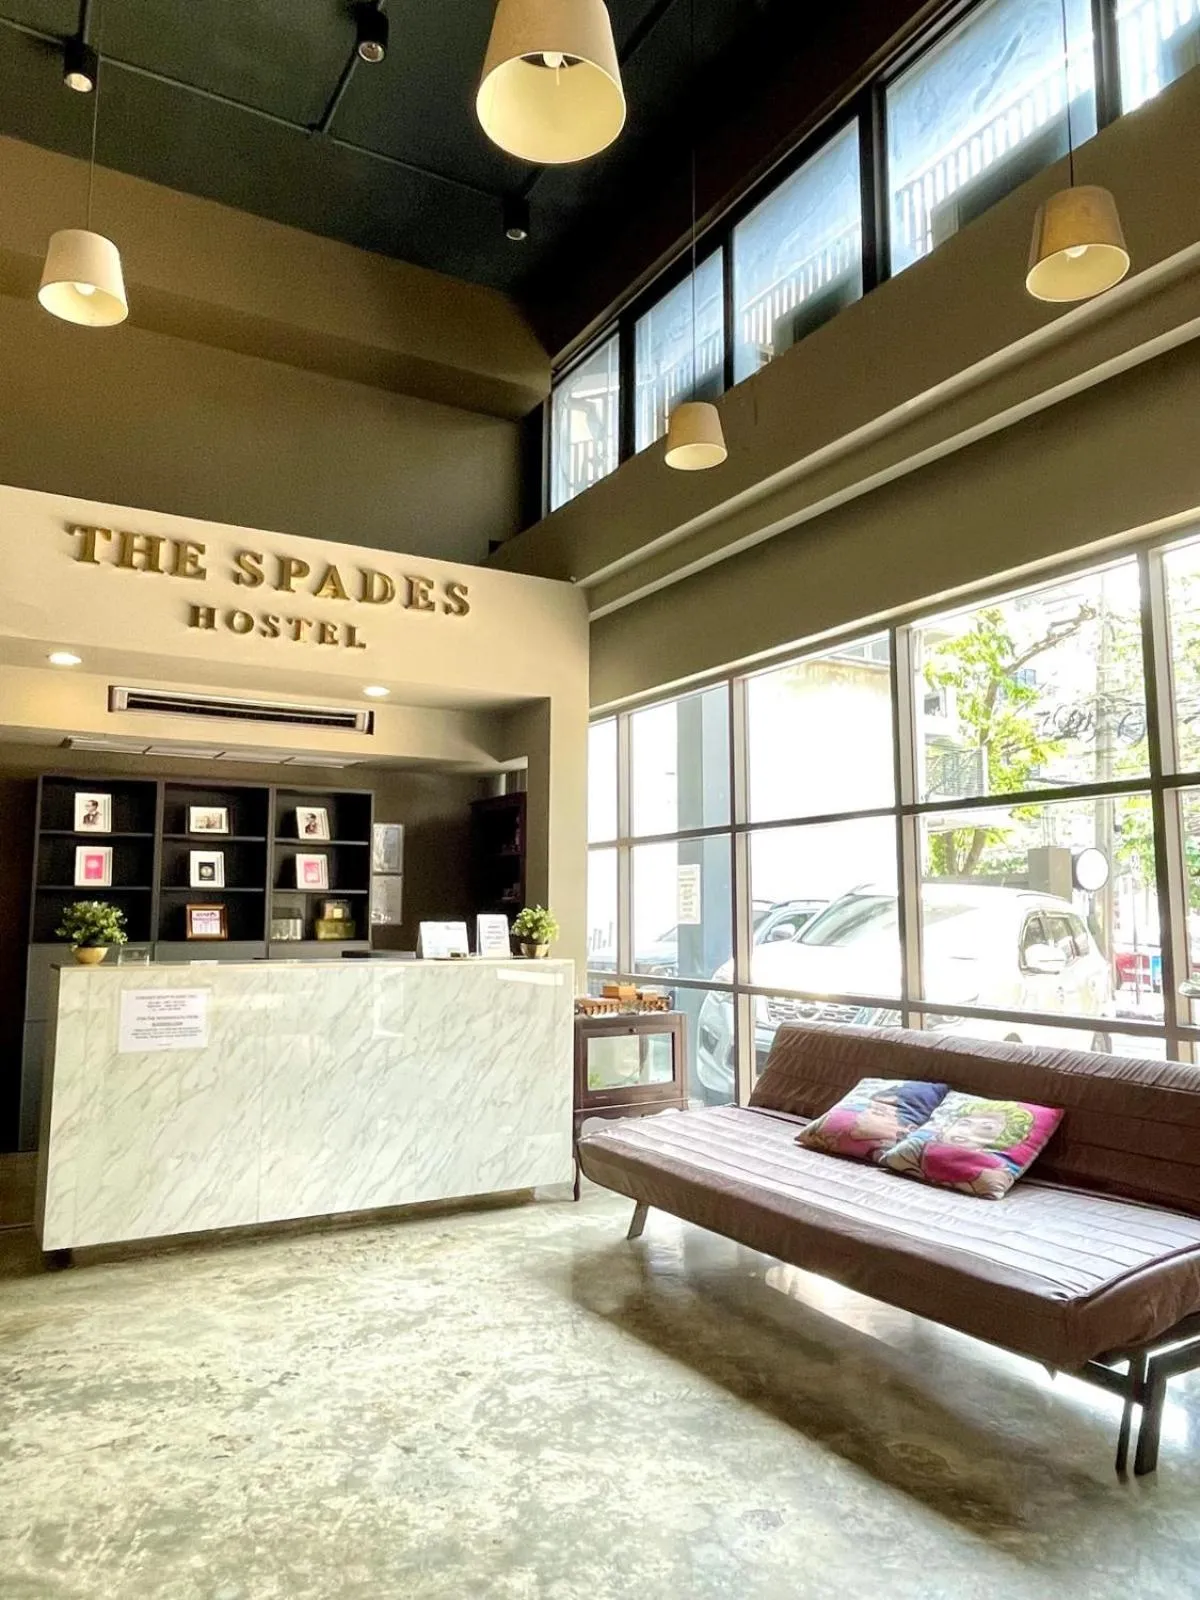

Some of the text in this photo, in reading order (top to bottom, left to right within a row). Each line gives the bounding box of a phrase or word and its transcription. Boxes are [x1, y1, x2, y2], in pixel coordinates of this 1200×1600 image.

[67, 523, 471, 617] THE SPADES
[188, 603, 367, 649] HOSTEL
